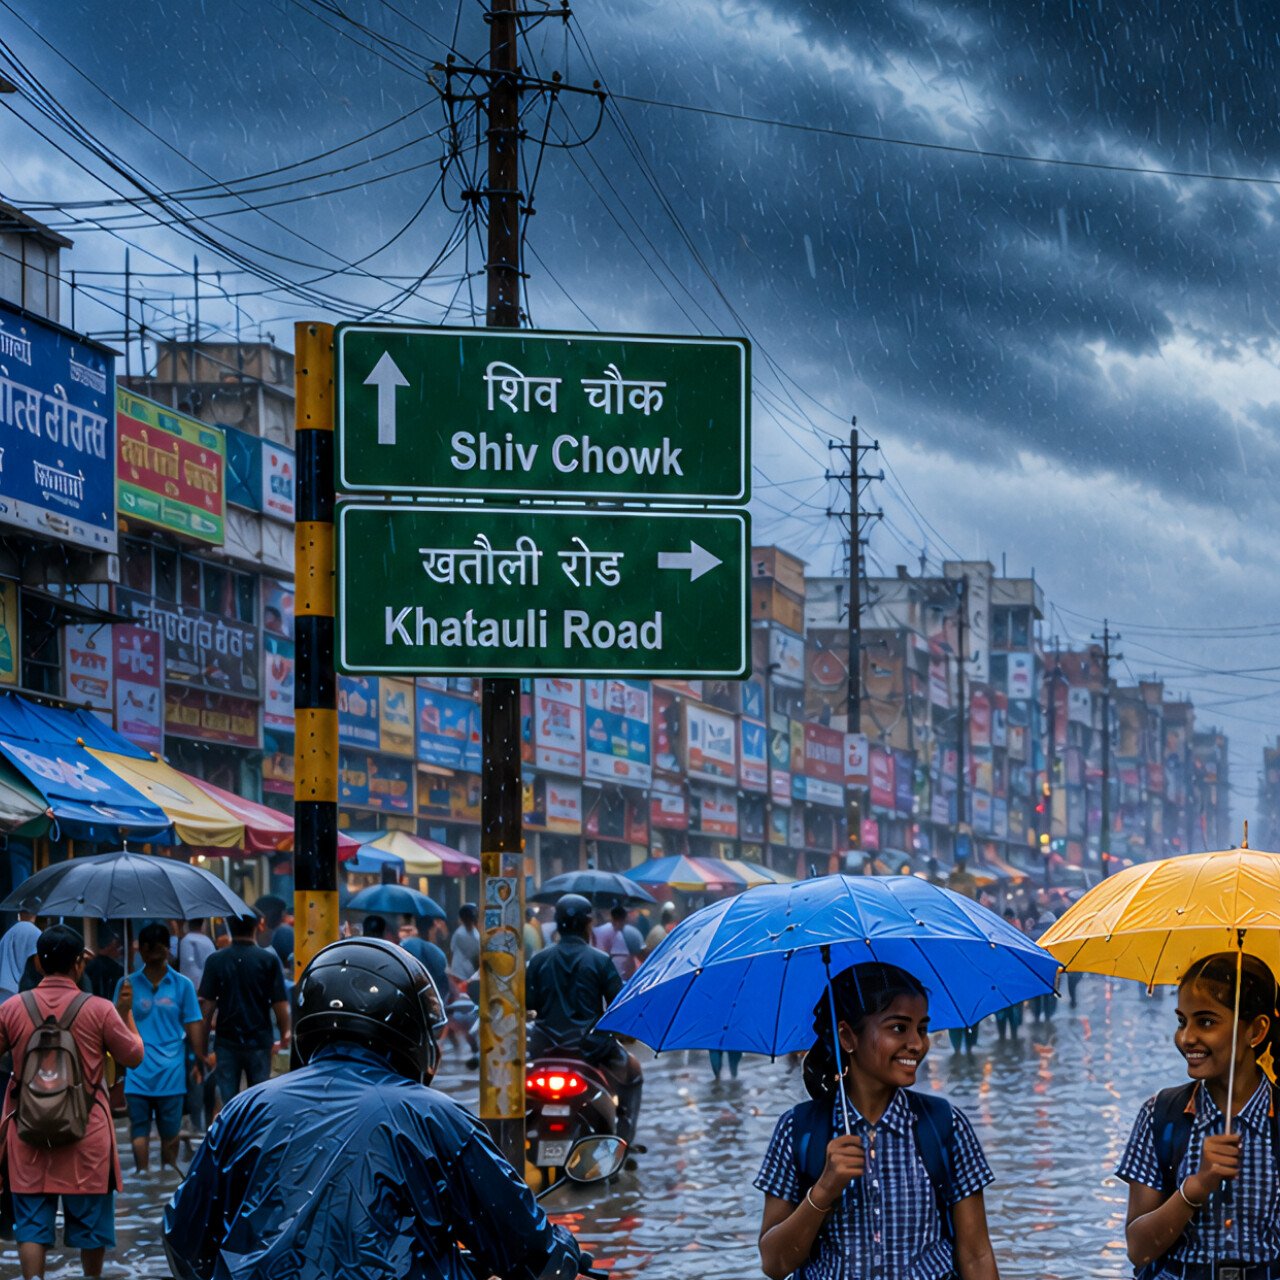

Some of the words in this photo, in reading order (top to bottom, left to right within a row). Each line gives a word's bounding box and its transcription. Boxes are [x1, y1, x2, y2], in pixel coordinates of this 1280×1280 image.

[484, 362, 562, 413] शिव
[581, 363, 667, 415] चौक
[450, 432, 538, 471] Shiv
[552, 435, 684, 476] Chowk
[419, 533, 543, 586] खतौली
[558, 536, 624, 587] रोड
[384, 606, 548, 648] Khatauli
[564, 611, 663, 650] Road
